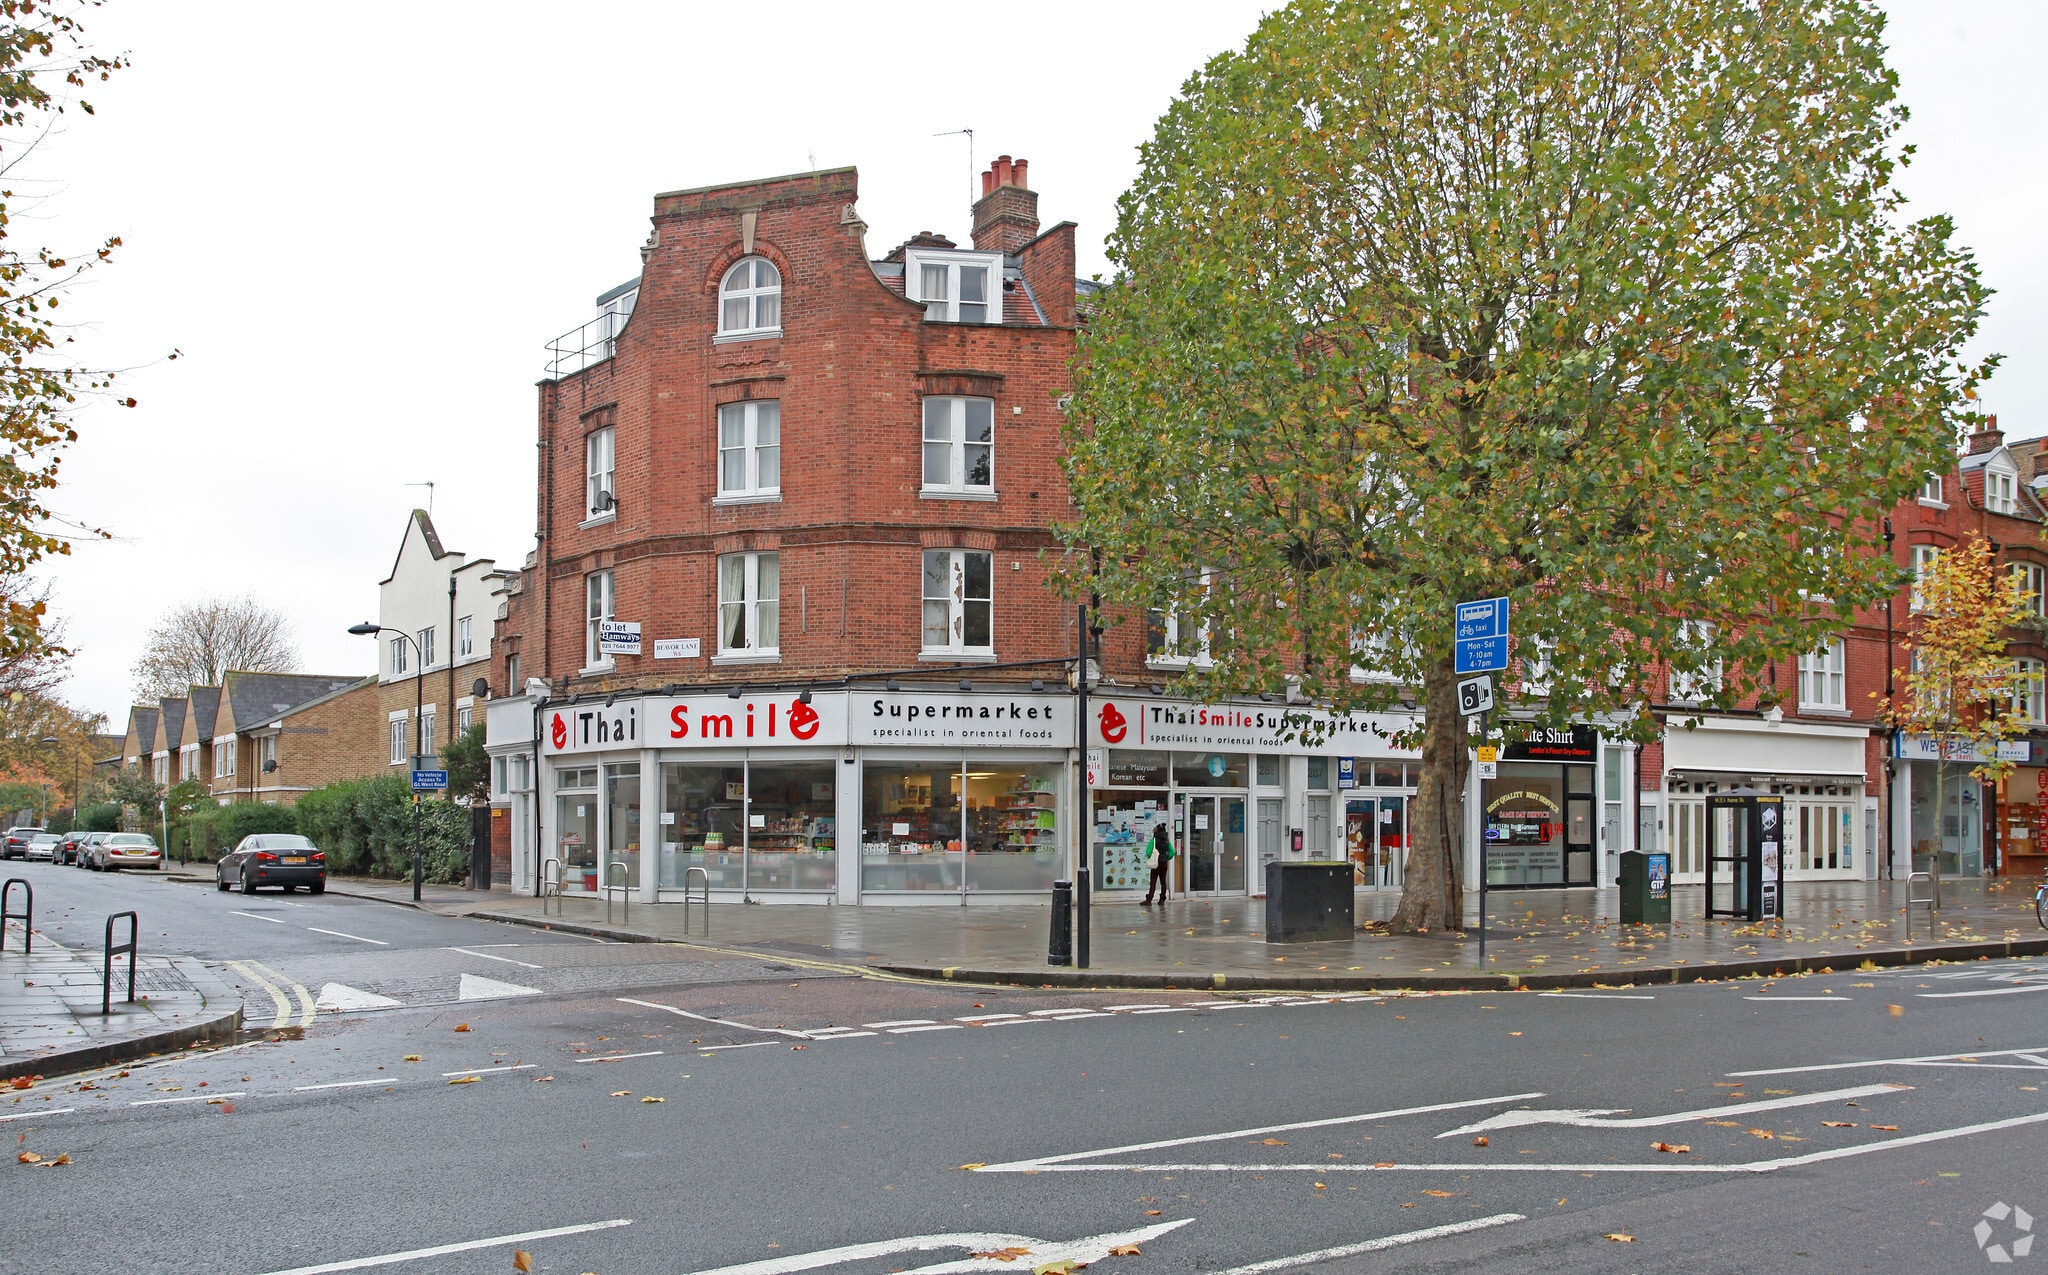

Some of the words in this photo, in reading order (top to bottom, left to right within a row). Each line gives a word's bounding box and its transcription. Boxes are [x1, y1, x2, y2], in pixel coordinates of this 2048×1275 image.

[602, 623, 611, 631] to
[614, 623, 626, 631] let
[602, 632, 640, 642] Hamways
[873, 700, 1053, 721] Supermarket
[578, 707, 635, 744] Thai
[873, 728, 935, 738] specialist
[943, 729, 954, 737] in
[962, 728, 1012, 738] oriental
[1020, 730, 1053, 739] foods
[1546, 728, 1574, 744] Shirt
[1151, 734, 1198, 743] specialist
[1217, 737, 1254, 745] oriental
[1260, 737, 1283, 746] foods
[1130, 764, 1158, 772] Malaysian
[1486, 799, 1500, 814] BEST
[1500, 791, 1524, 804] QUALITY
[1526, 791, 1539, 800] BEST
[1539, 795, 1560, 814] SERVICE
